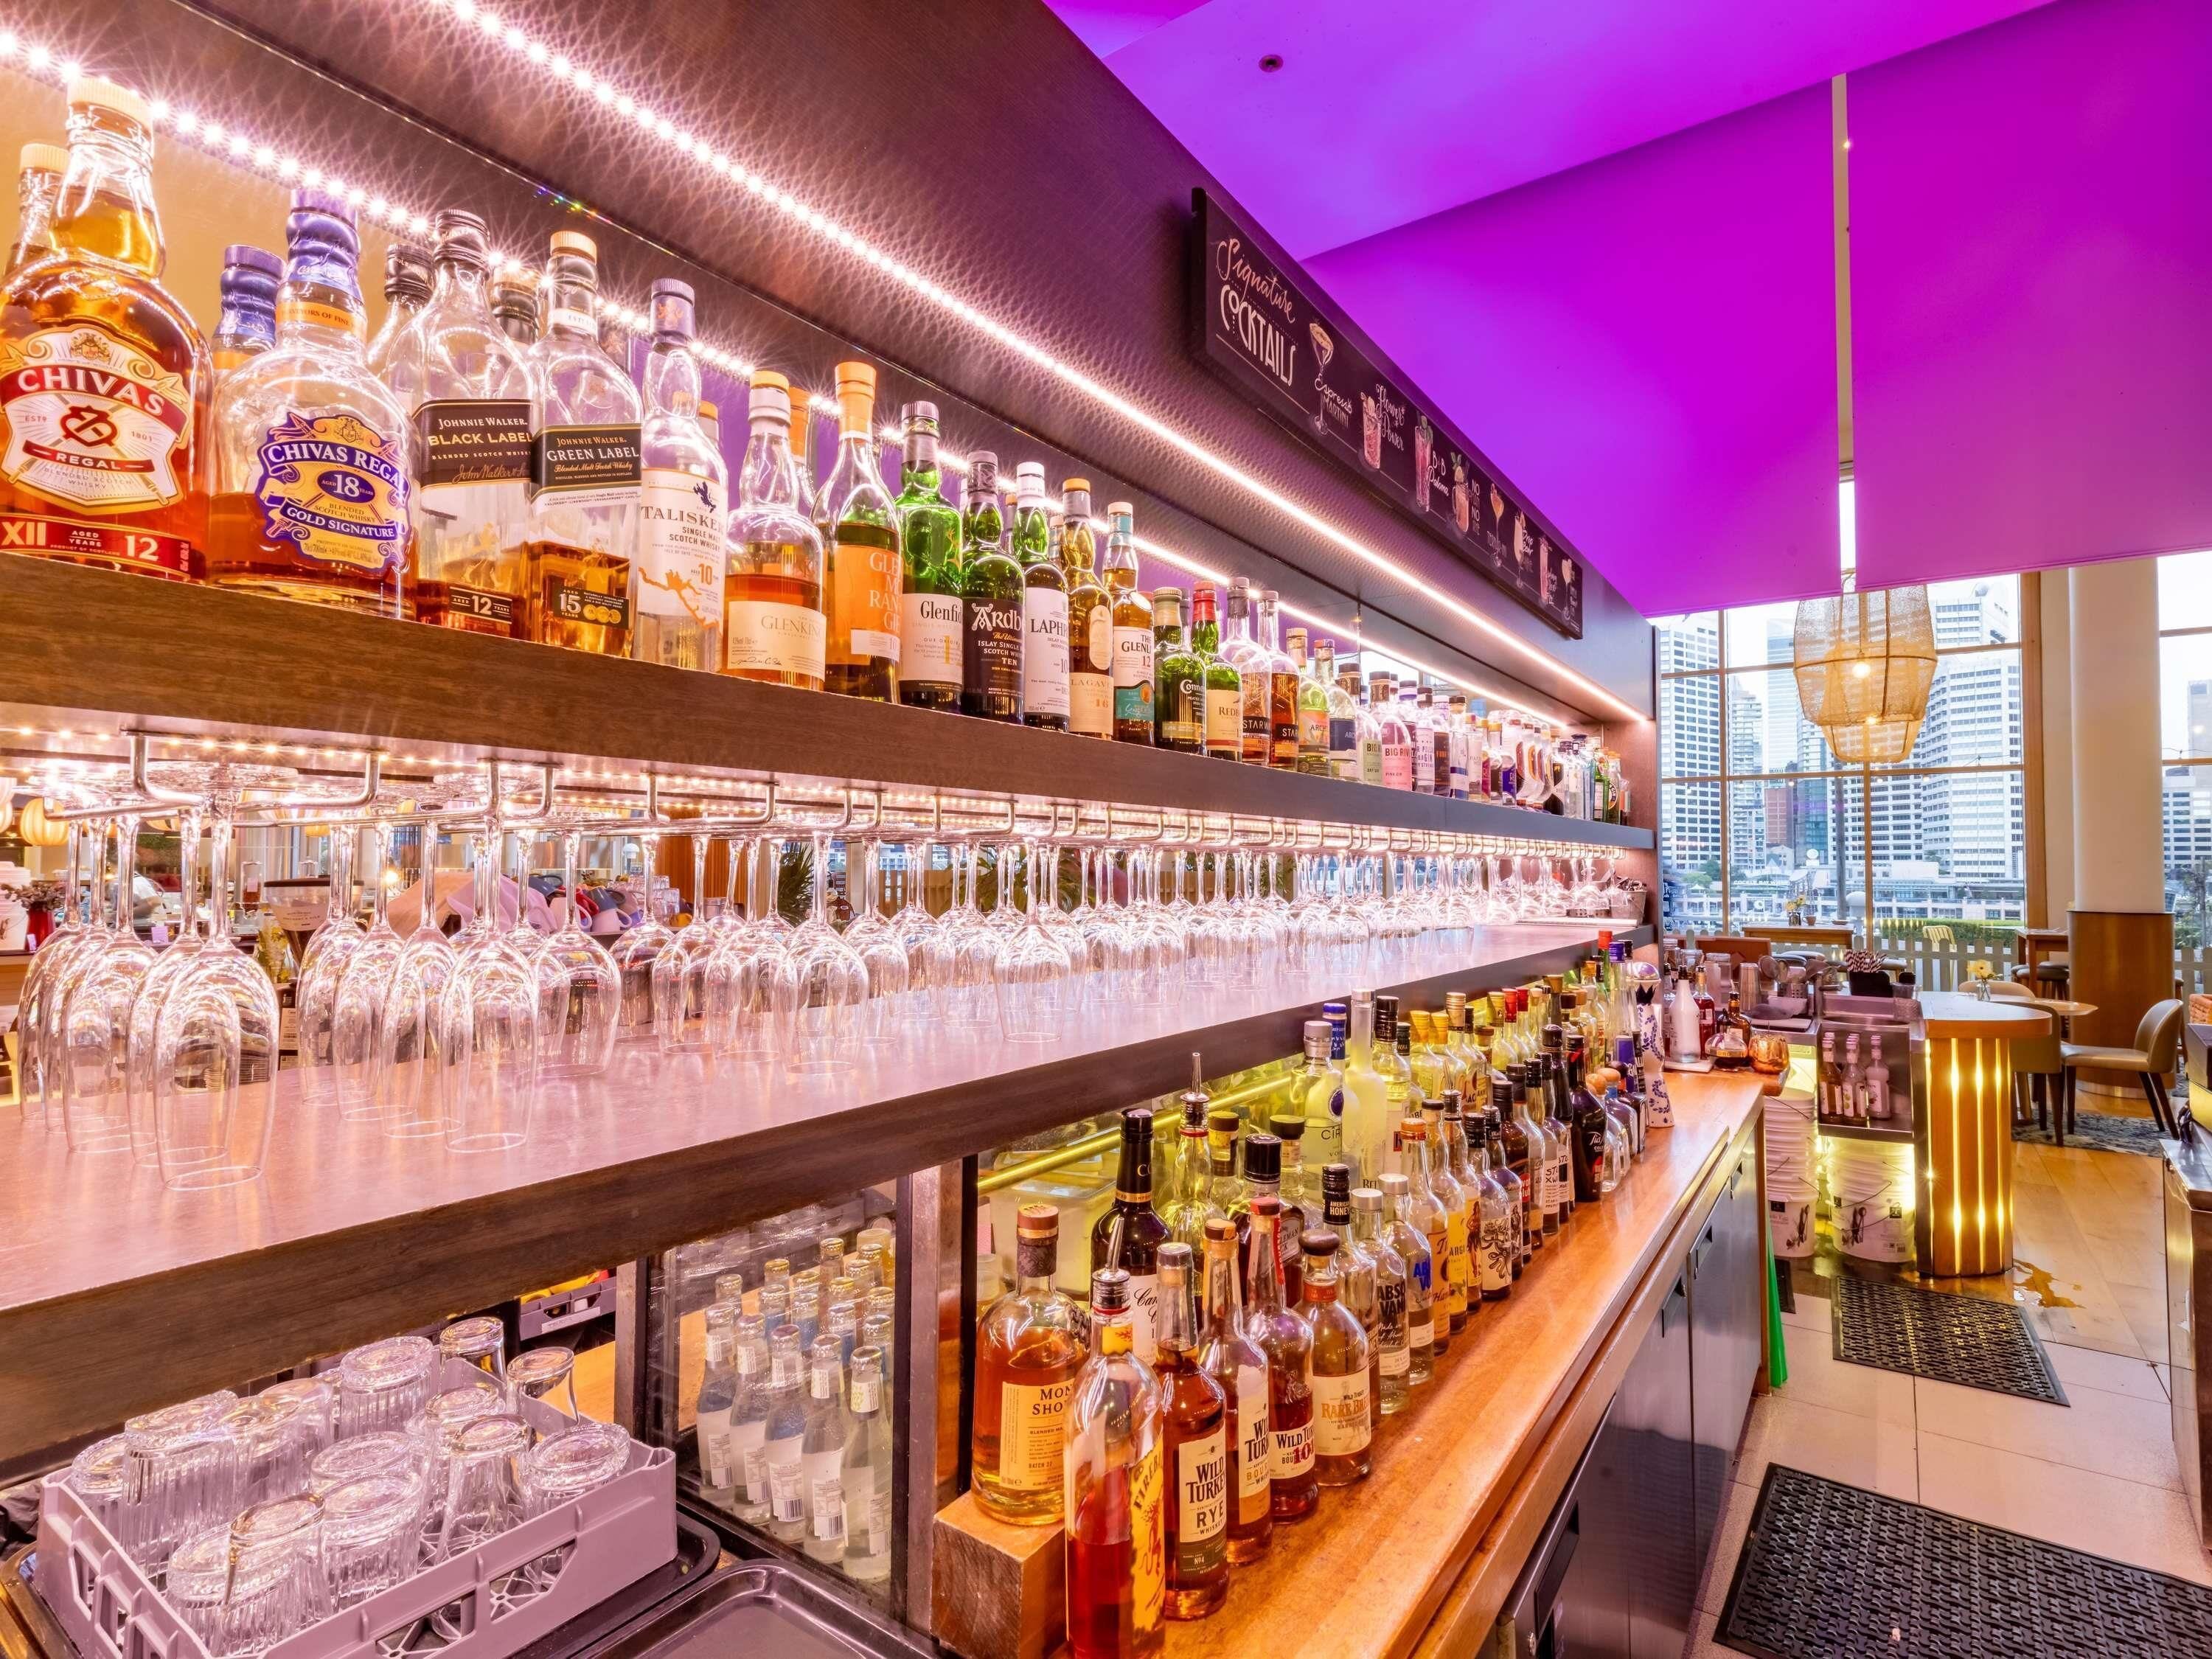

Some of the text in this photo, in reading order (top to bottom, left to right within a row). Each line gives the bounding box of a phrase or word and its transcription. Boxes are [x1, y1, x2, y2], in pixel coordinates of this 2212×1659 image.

[1217, 238, 1295, 323] Signature
[1220, 285, 1296, 386] COCKTAILS
[18, 367, 164, 416] CHIVAS
[1315, 373, 1353, 414] Espresso
[439, 417, 484, 430] JOHNNIE
[131, 431, 153, 442] 1801
[428, 434, 484, 446] BLACK
[557, 437, 592, 447] JOHNNIE
[268, 443, 348, 463] CHIVAS
[546, 447, 640, 462] GREEN LABEL
[56, 452, 121, 470] REGAL
[554, 464, 579, 473] Blended
[579, 462, 595, 471] Malt
[613, 461, 633, 470] Whisky
[44, 467, 90, 481] BLENDED
[69, 479, 106, 490] WHISKY
[333, 474, 361, 498] 18
[359, 487, 373, 495] YEARS
[314, 505, 376, 523] SCOTCH WHISKY
[329, 503, 365, 515] BLENDED
[286, 507, 395, 538] GOLD SIGNATURE
[1, 521, 46, 546] XII
[72, 530, 100, 538] AGED
[669, 533, 698, 545] SCOTCH
[682, 526, 706, 540] SINGLE
[69, 539, 102, 547] YEARS
[125, 535, 159, 562] 12
[698, 563, 712, 585] 10
[472, 594, 492, 616] 12
[494, 605, 509, 613] YEARS
[560, 593, 581, 614] 15
[999, 641, 1019, 651] SINGLE
[1001, 657, 1018, 666] TEN
[1142, 655, 1151, 668] 12
[1096, 698, 1109, 709] 16
[1385, 748, 1399, 757] BIG
[1321, 1402, 1352, 1419] RARE
[1276, 1433, 1303, 1450] WILD
[1293, 1441, 1315, 1464] 101
[1196, 1455, 1224, 1484] WILD
[1197, 1500, 1224, 1528] RYE
